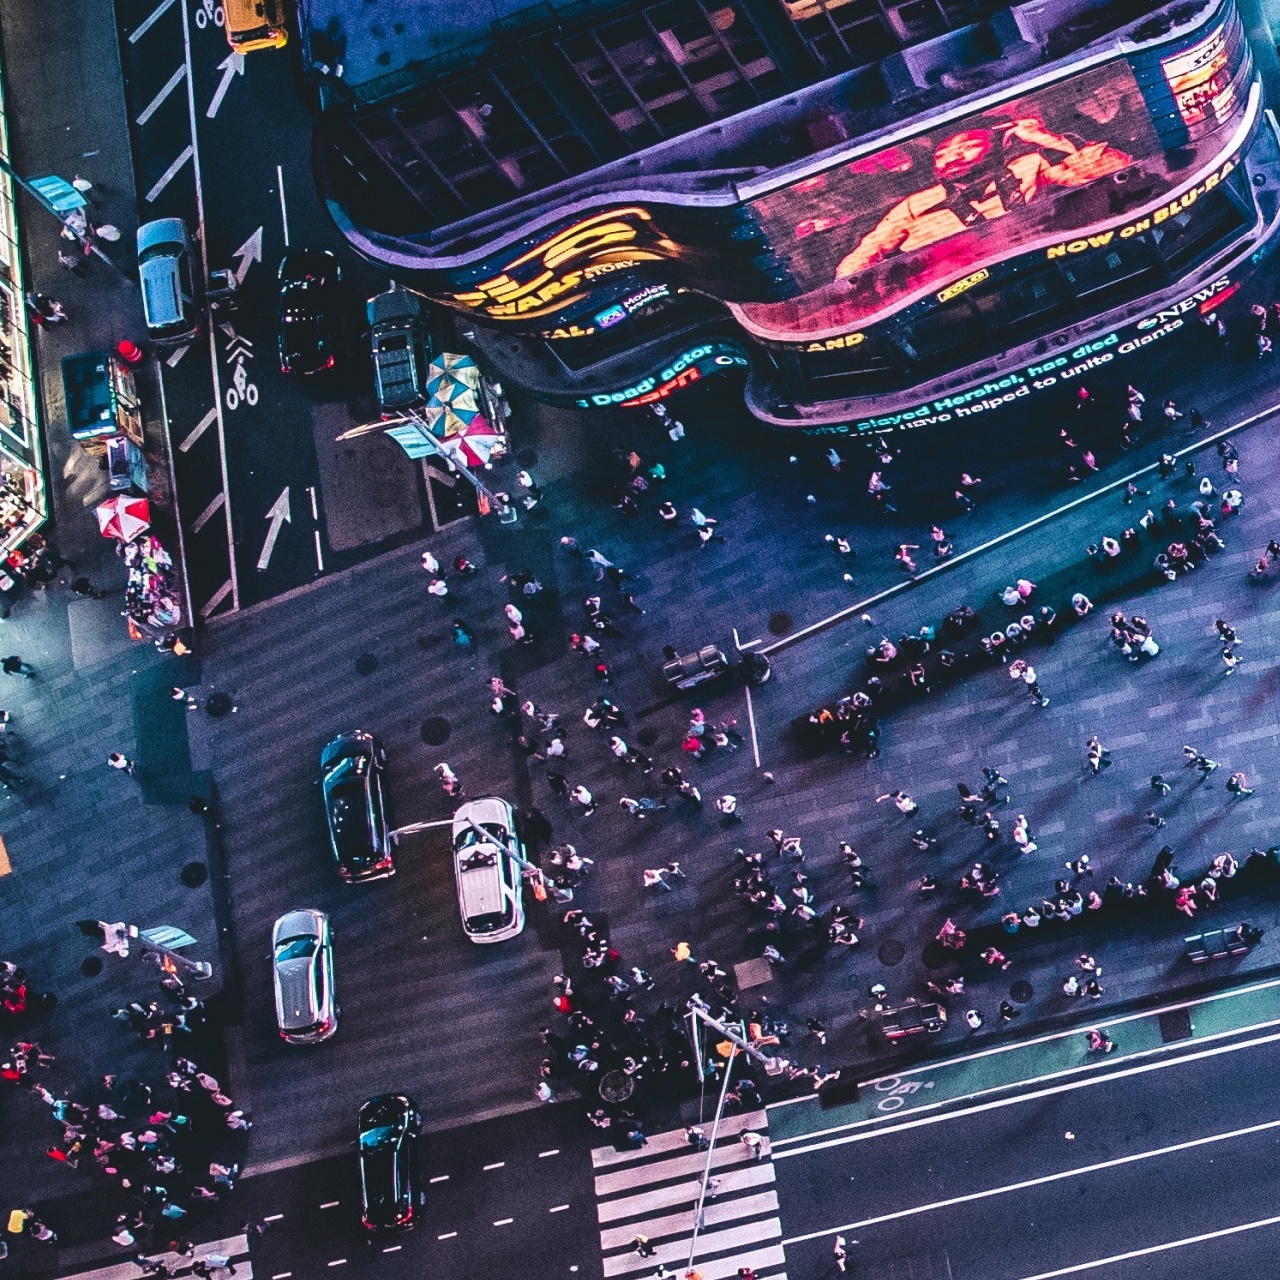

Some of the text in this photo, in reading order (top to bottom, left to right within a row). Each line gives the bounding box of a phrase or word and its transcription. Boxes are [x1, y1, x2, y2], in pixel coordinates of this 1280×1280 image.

[1047, 231, 1114, 260] NOW
[1119, 219, 1150, 240] ON
[485, 270, 584, 317] WARS
[1155, 276, 1231, 324] NEWS
[661, 343, 714, 382] actor
[856, 405, 931, 433] played
[934, 373, 1025, 412] Hershel,
[1028, 355, 1069, 379] has
[1072, 333, 1119, 360] died
[955, 385, 1031, 419] helped
[1033, 376, 1057, 391] to
[1061, 352, 1114, 381] unite
[1117, 318, 1184, 355] Giants
